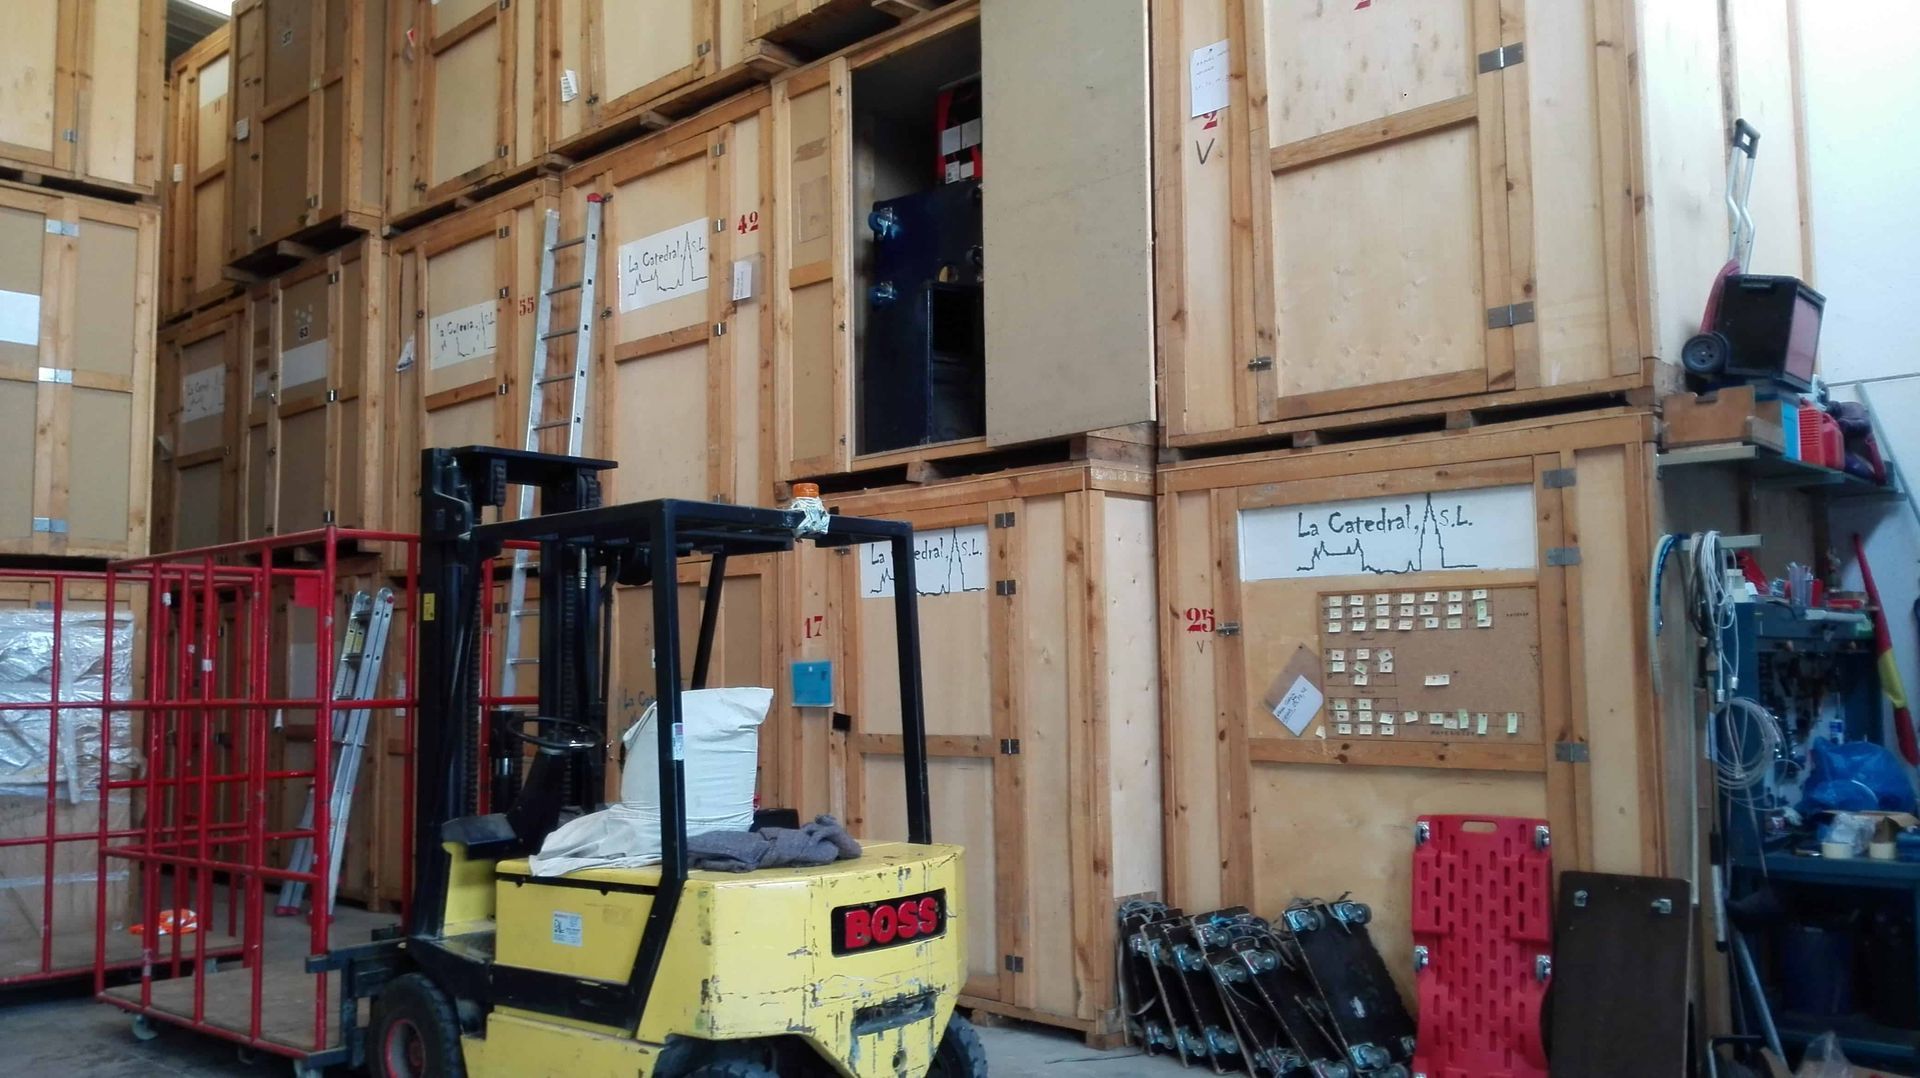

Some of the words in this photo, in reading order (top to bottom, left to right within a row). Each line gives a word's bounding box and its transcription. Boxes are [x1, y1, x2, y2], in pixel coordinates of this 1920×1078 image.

[737, 211, 759, 235] 42
[628, 253, 640, 273] La
[519, 296, 535, 317] 55
[1297, 511, 1320, 538] La
[1328, 503, 1420, 536] Catedral,
[1438, 504, 1474, 528] S.L.
[871, 543, 886, 565] La
[914, 536, 949, 563] edral,
[961, 538, 983, 557] S.L.
[804, 615, 824, 639] 17
[1186, 607, 1216, 633] 25
[844, 896, 939, 949] BOSS
